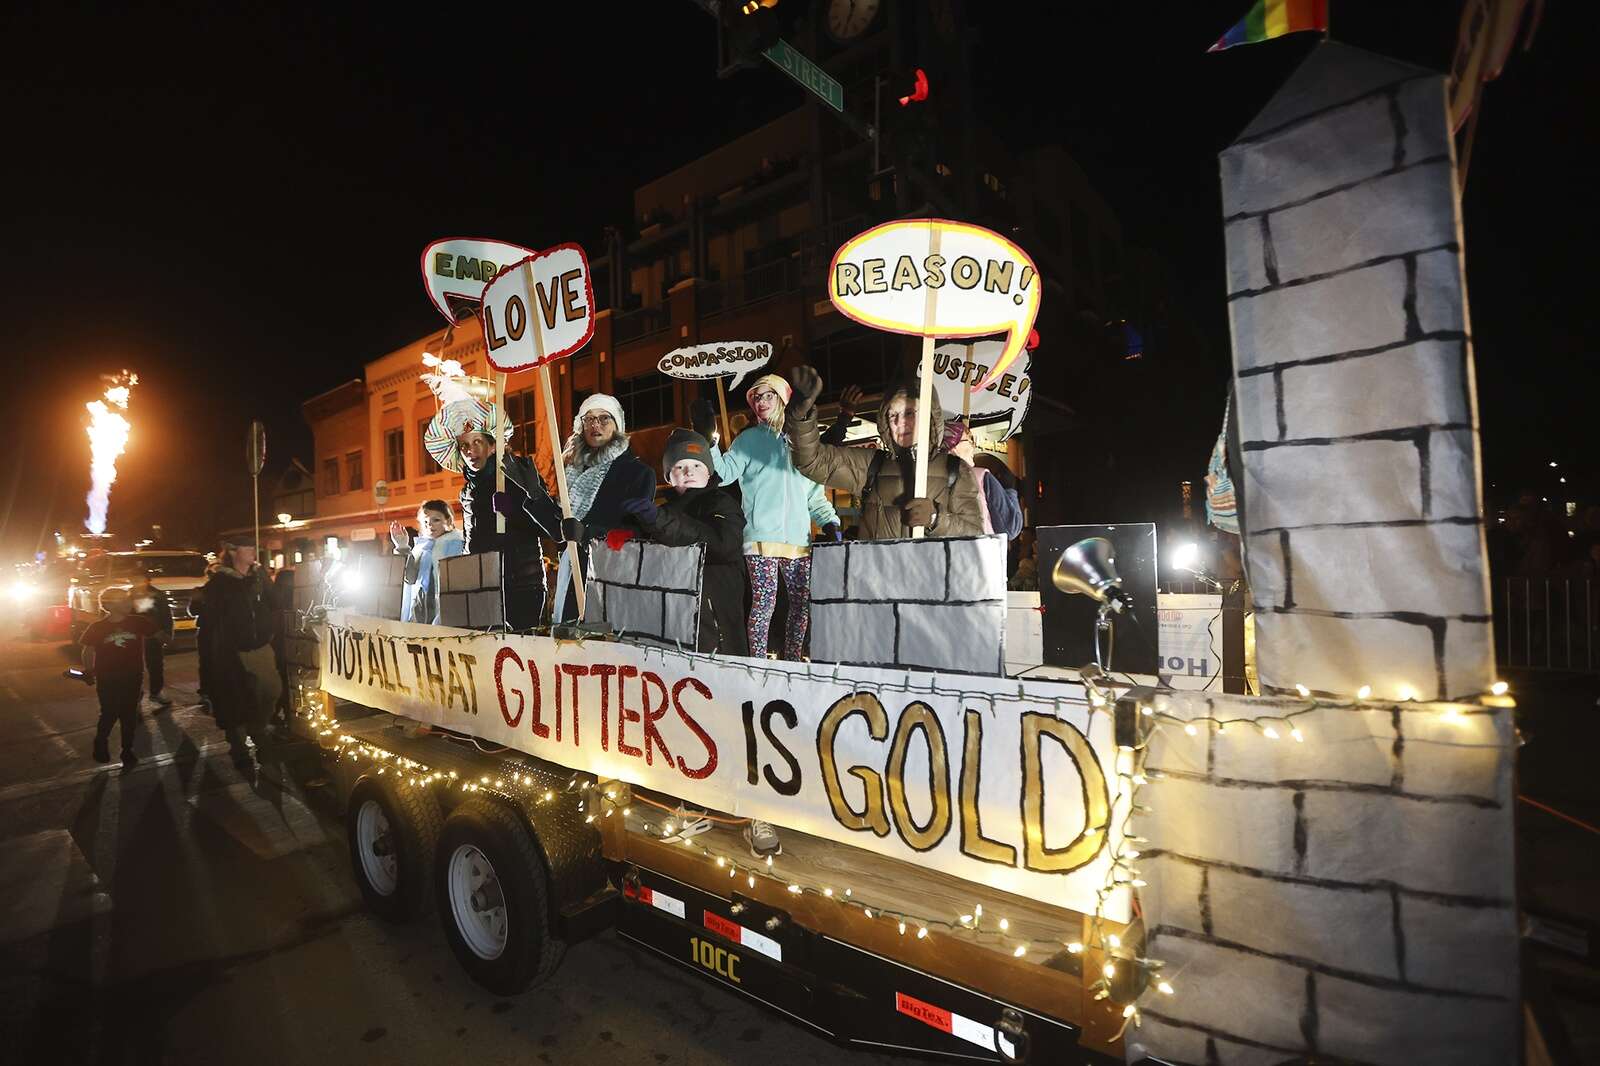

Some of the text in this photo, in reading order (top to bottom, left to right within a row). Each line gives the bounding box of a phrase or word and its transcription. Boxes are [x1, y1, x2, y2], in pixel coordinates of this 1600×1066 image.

[784, 46, 834, 101] STREET
[836, 254, 1036, 305] REASON!
[485, 269, 586, 351] LOVE
[660, 344, 769, 371] COMPASSION
[920, 353, 1030, 402] USTIE!
[329, 627, 1112, 874] NOT ALL THAT GLITTERS IS GOLD
[690, 936, 741, 983] 10CC
